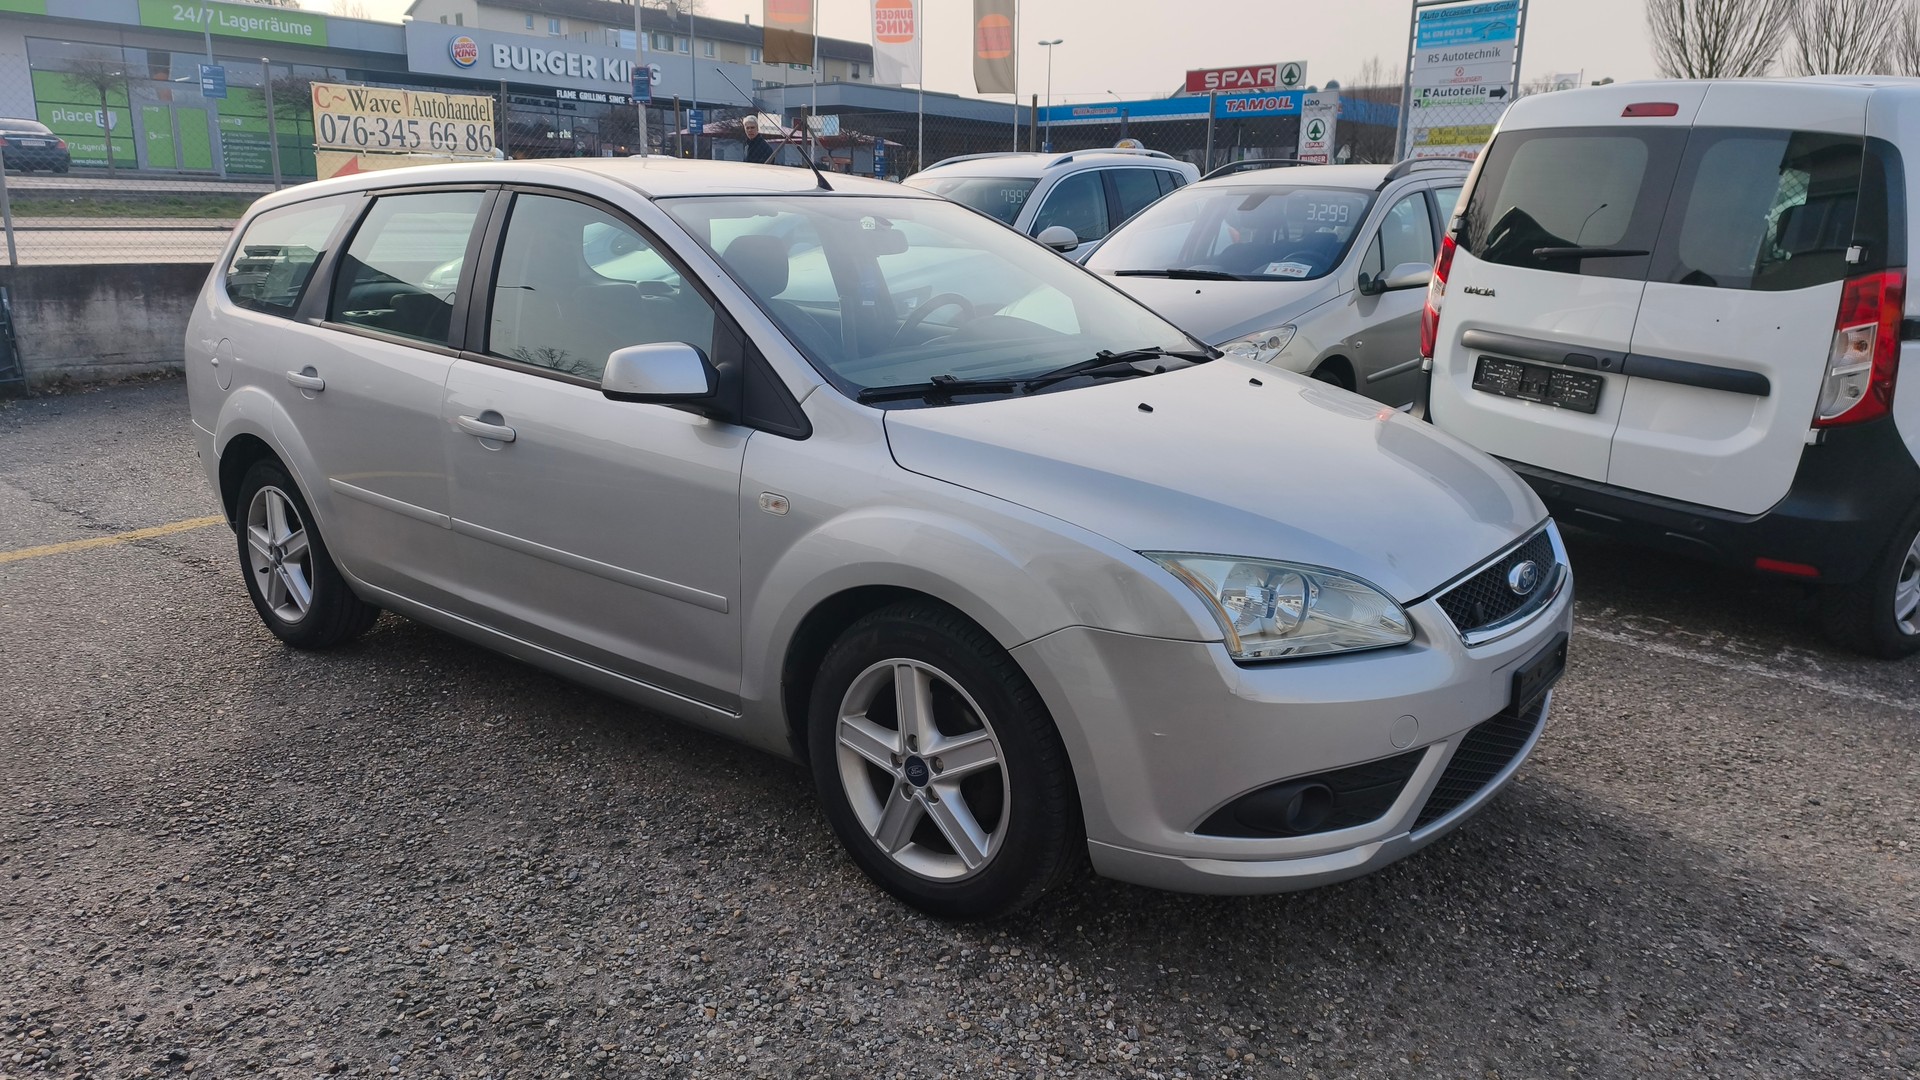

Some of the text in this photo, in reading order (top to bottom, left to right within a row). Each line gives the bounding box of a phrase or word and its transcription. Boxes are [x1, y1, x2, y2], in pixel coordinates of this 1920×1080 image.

[1422, 12, 1439, 20] Auto
[1441, 9, 1471, 18] Occasion
[1493, 2, 1518, 12] GmbH
[172, 5, 312, 36] 24/7 Lagerräume
[453, 42, 476, 51] BURGER
[454, 48, 477, 58] KING
[492, 43, 598, 79] BURGER
[1428, 47, 1502, 63] RS Autotechnik
[1204, 67, 1275, 89] SPAR
[556, 89, 577, 100] FLAME
[579, 91, 607, 103] GRILLING
[608, 94, 626, 104] SINCE
[1432, 84, 1487, 97] Autoteile
[412, 94, 492, 122] Autohandel
[1226, 96, 1294, 113] TAMOIL
[52, 108, 93, 123] place
[320, 113, 493, 153] 076-345 66 86
[77, 142, 121, 152] Lagerräme
[1305, 141, 1325, 149] SPAR
[1307, 203, 1349, 223] 3.299
